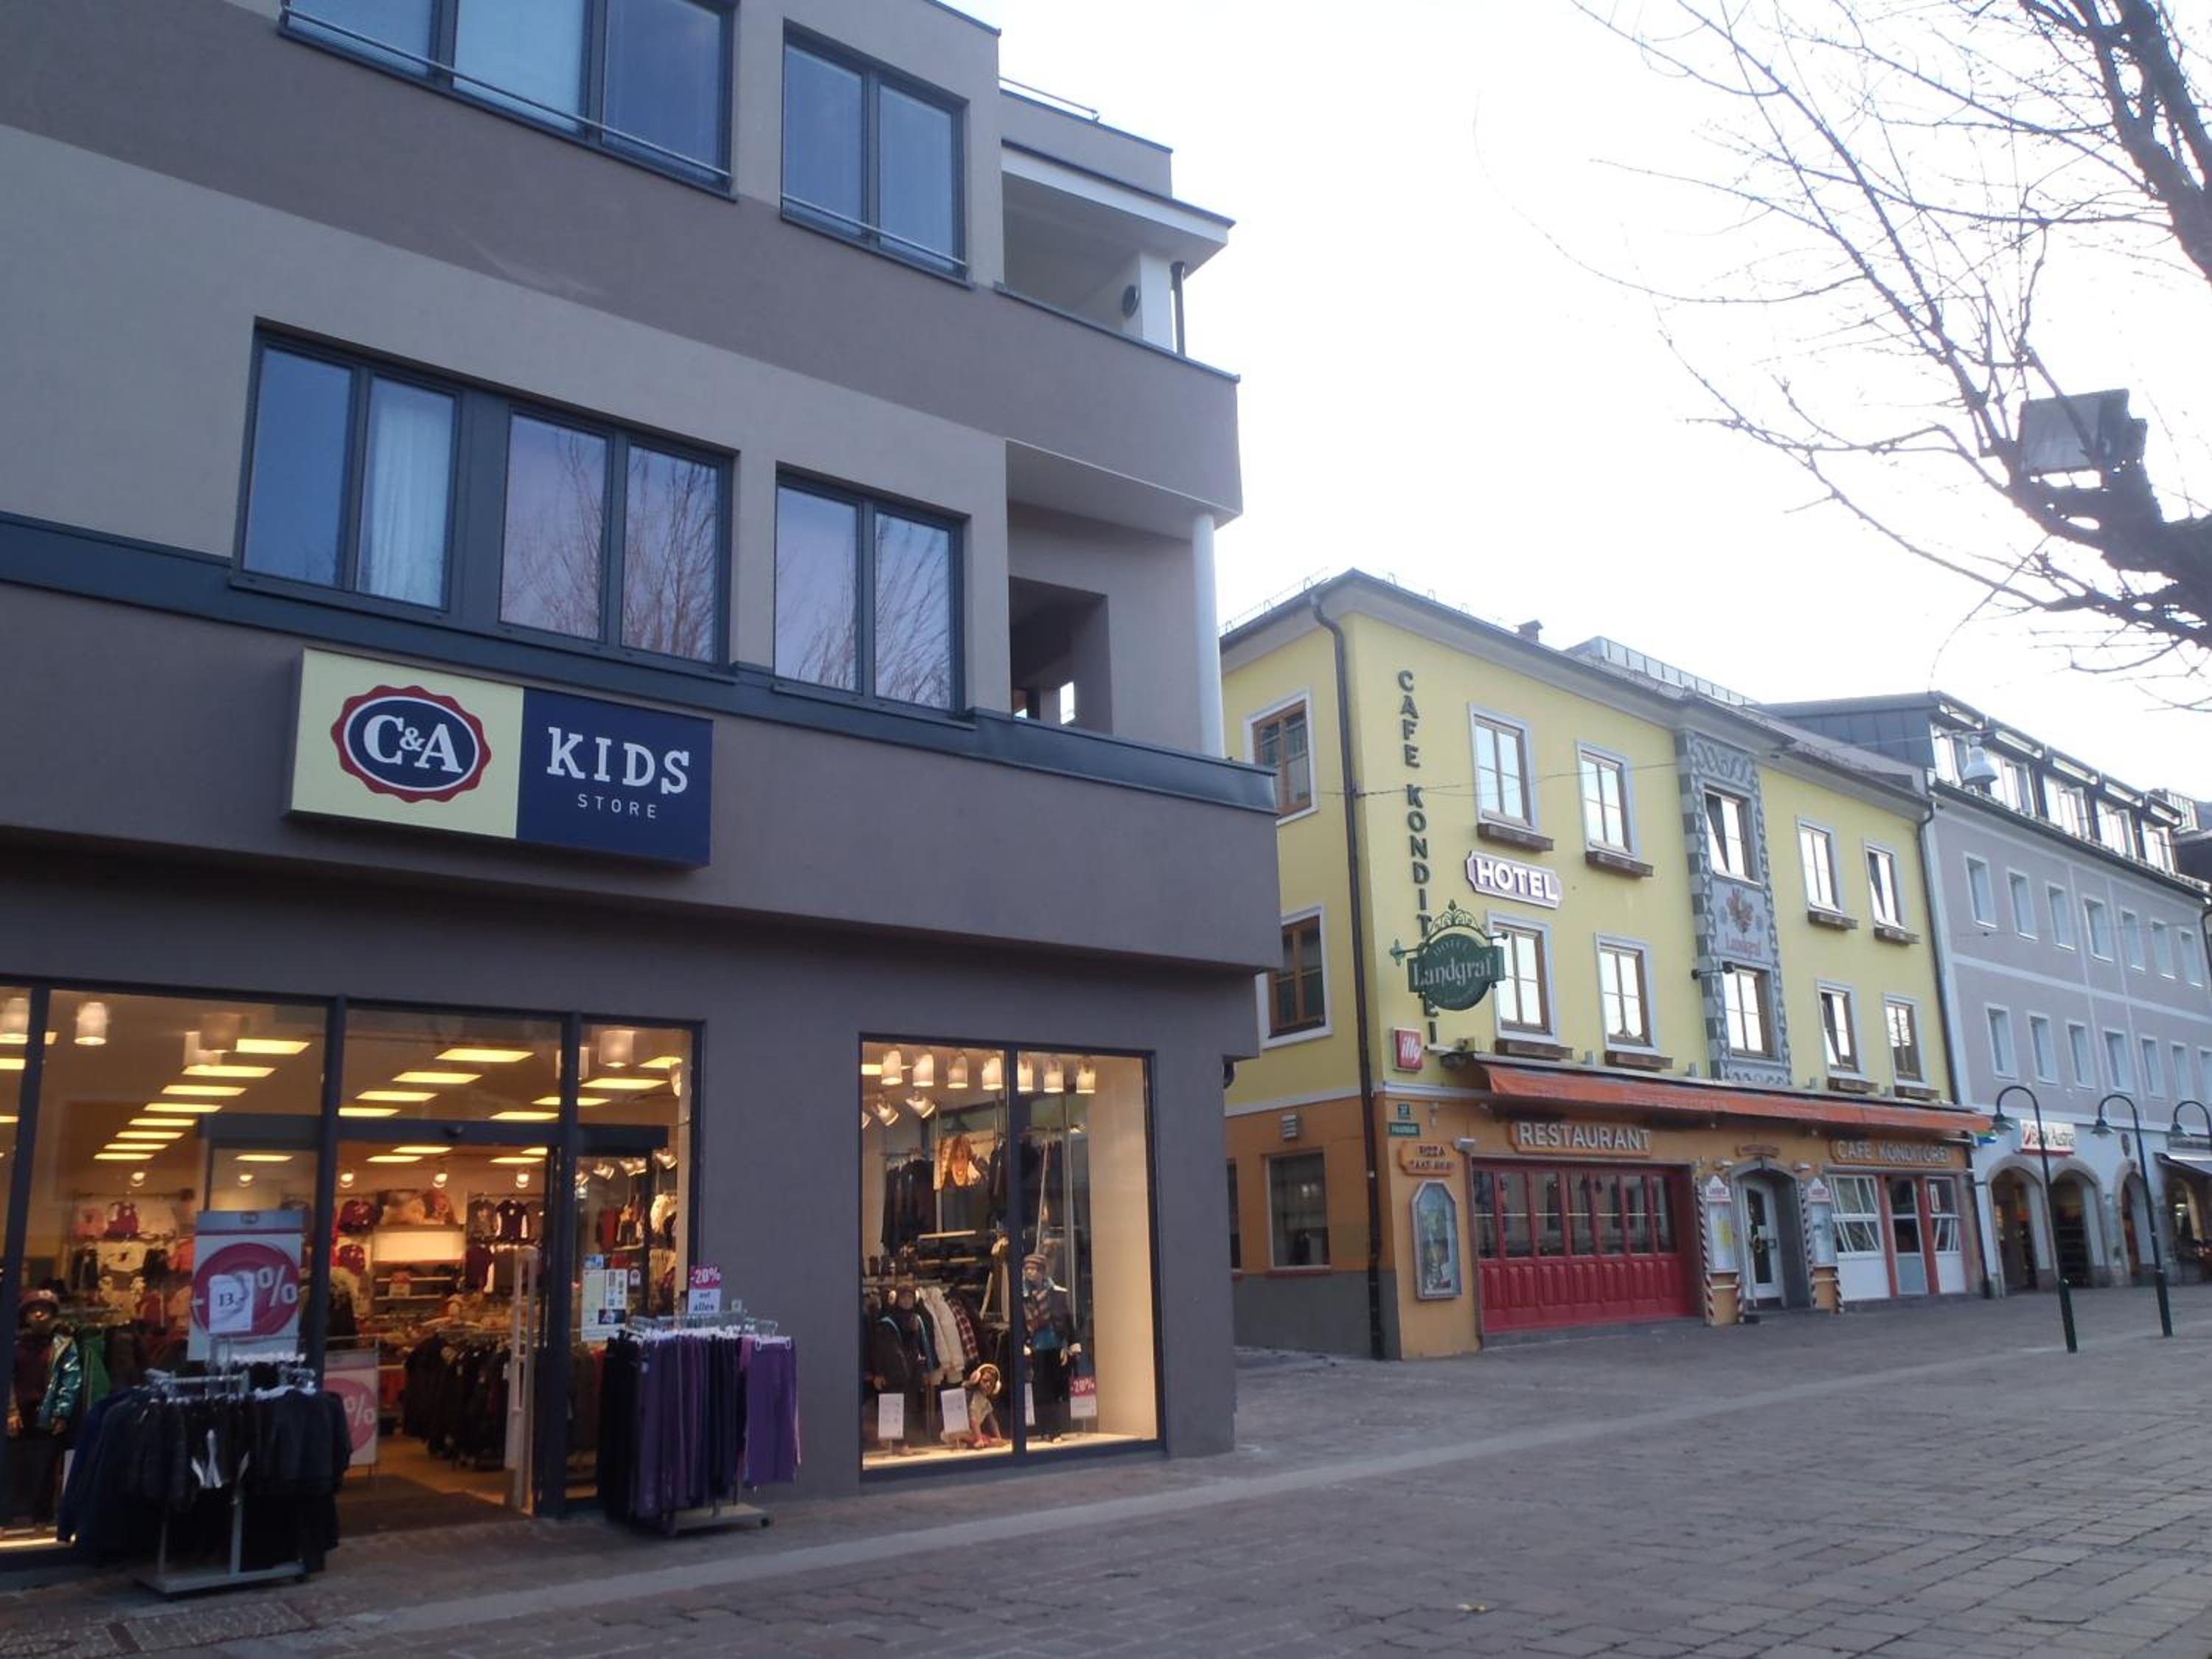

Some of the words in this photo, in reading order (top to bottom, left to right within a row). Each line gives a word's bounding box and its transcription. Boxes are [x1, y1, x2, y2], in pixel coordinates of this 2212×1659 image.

[1398, 670, 1420, 768] CAFE
[363, 714, 463, 773] C&A
[546, 727, 690, 794] KIDS
[577, 794, 657, 818] STORE
[1474, 858, 1558, 900] HOTEL
[1407, 784, 1439, 1044] KONDITEI
[1413, 953, 1494, 988] Landgraf
[1401, 1037, 1422, 1063] illy
[1519, 1121, 1651, 1150] RESTAURANT
[1837, 1140, 1872, 1158] CAFE
[690, 1267, 720, 1285] -20%
